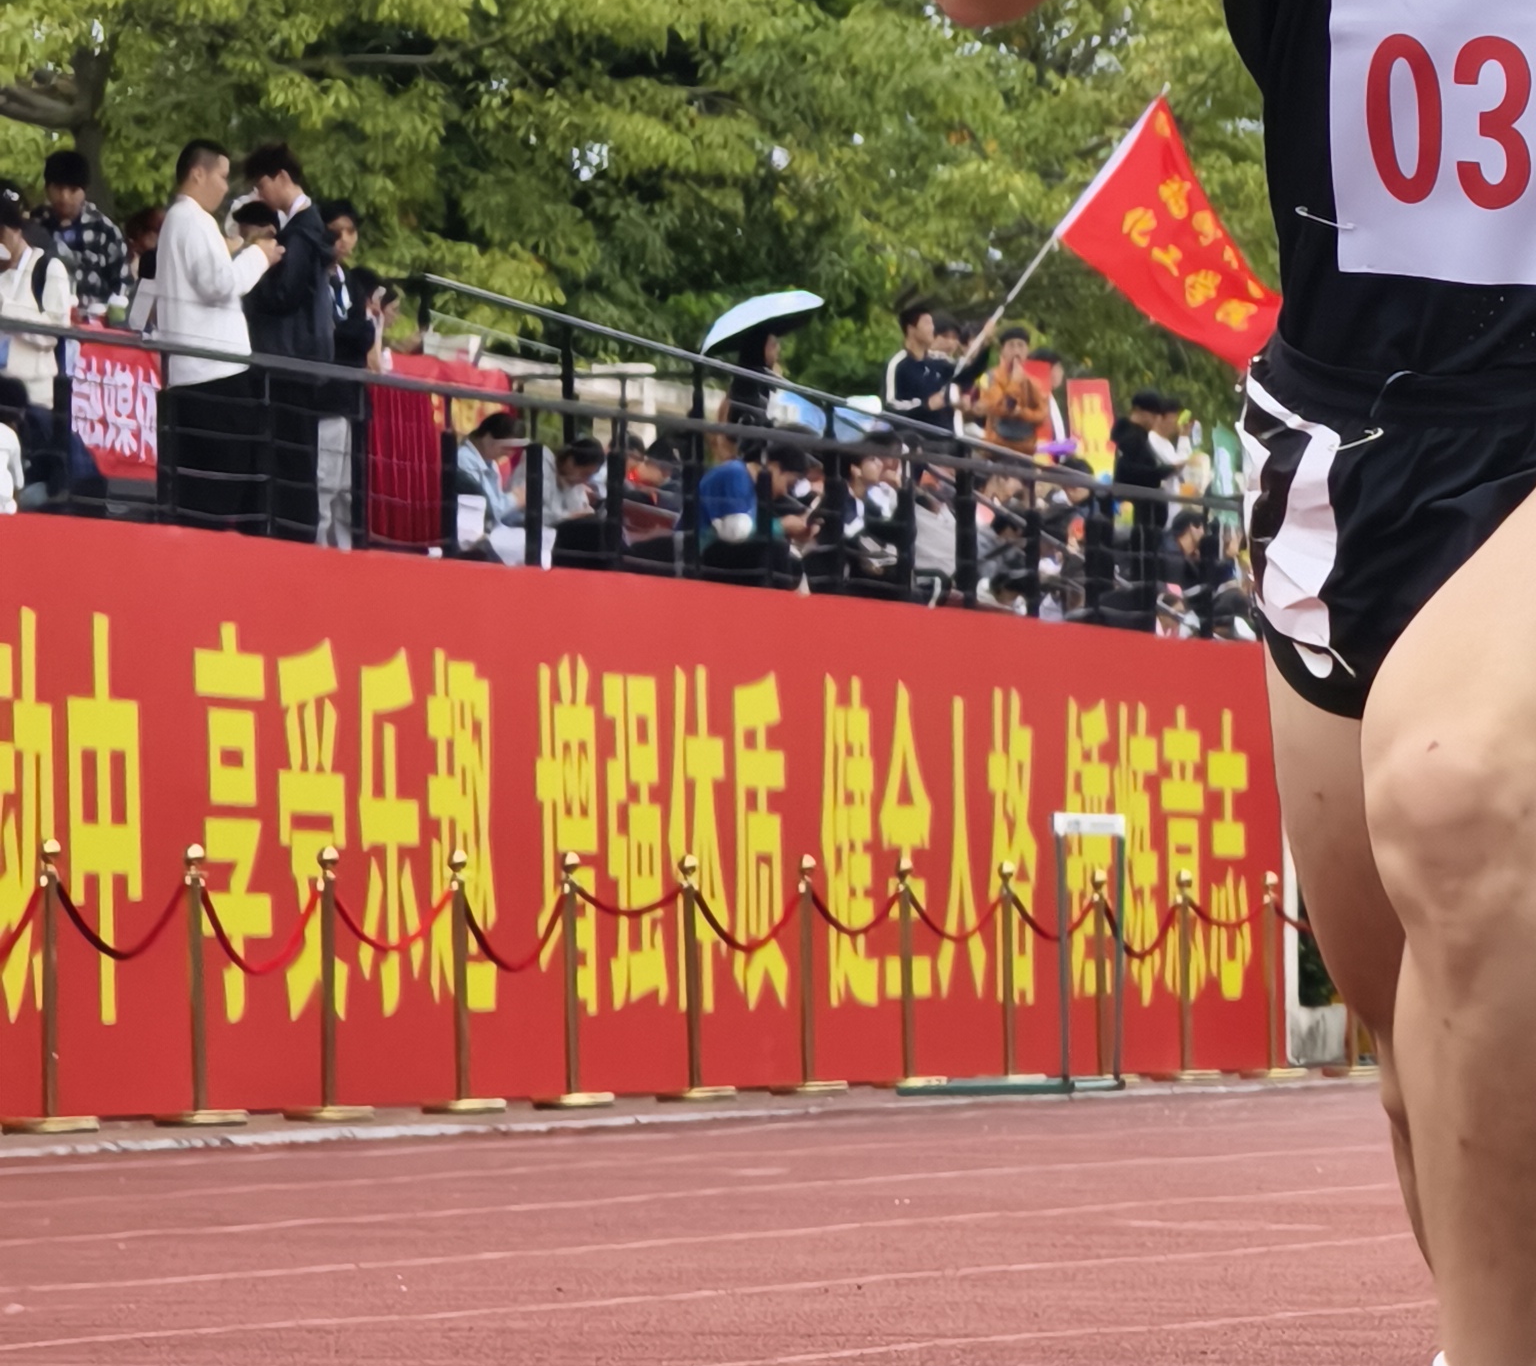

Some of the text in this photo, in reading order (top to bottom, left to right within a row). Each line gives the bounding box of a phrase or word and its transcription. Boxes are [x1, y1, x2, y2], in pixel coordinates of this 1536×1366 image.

[192, 621, 498, 1024] 享受乐趣
[535, 653, 788, 1017] 增强体质
[821, 672, 1037, 1009] 健全人格
